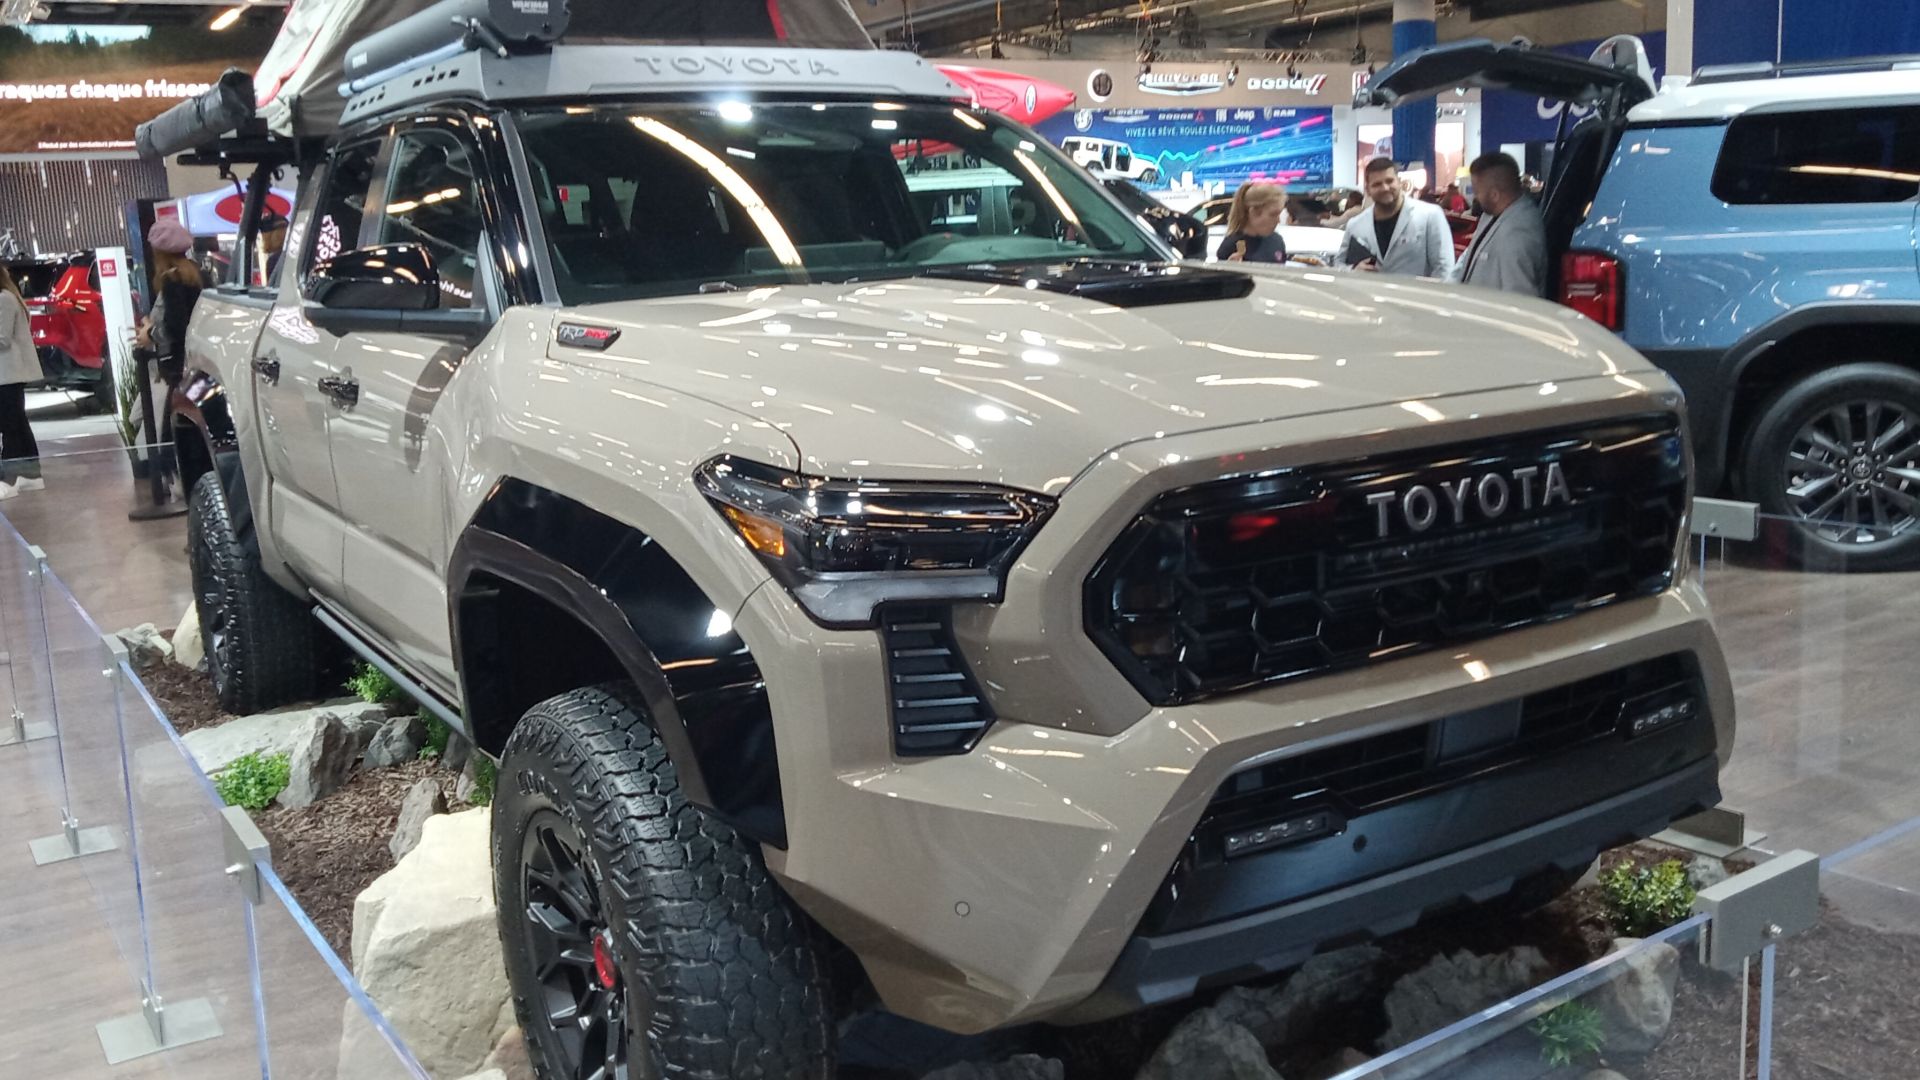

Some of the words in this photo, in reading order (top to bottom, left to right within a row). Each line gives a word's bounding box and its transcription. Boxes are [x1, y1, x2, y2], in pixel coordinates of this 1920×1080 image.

[633, 56, 840, 76] TOYOTA
[70, 79, 143, 102] chaque
[1234, 108, 1255, 121] Jeep
[1273, 109, 1296, 118] RAM
[1125, 127, 1146, 138] VIVEZ
[1148, 127, 1156, 137] LE
[1180, 126, 1208, 136] ROULEZ
[1366, 462, 1571, 537] TOYOTA
